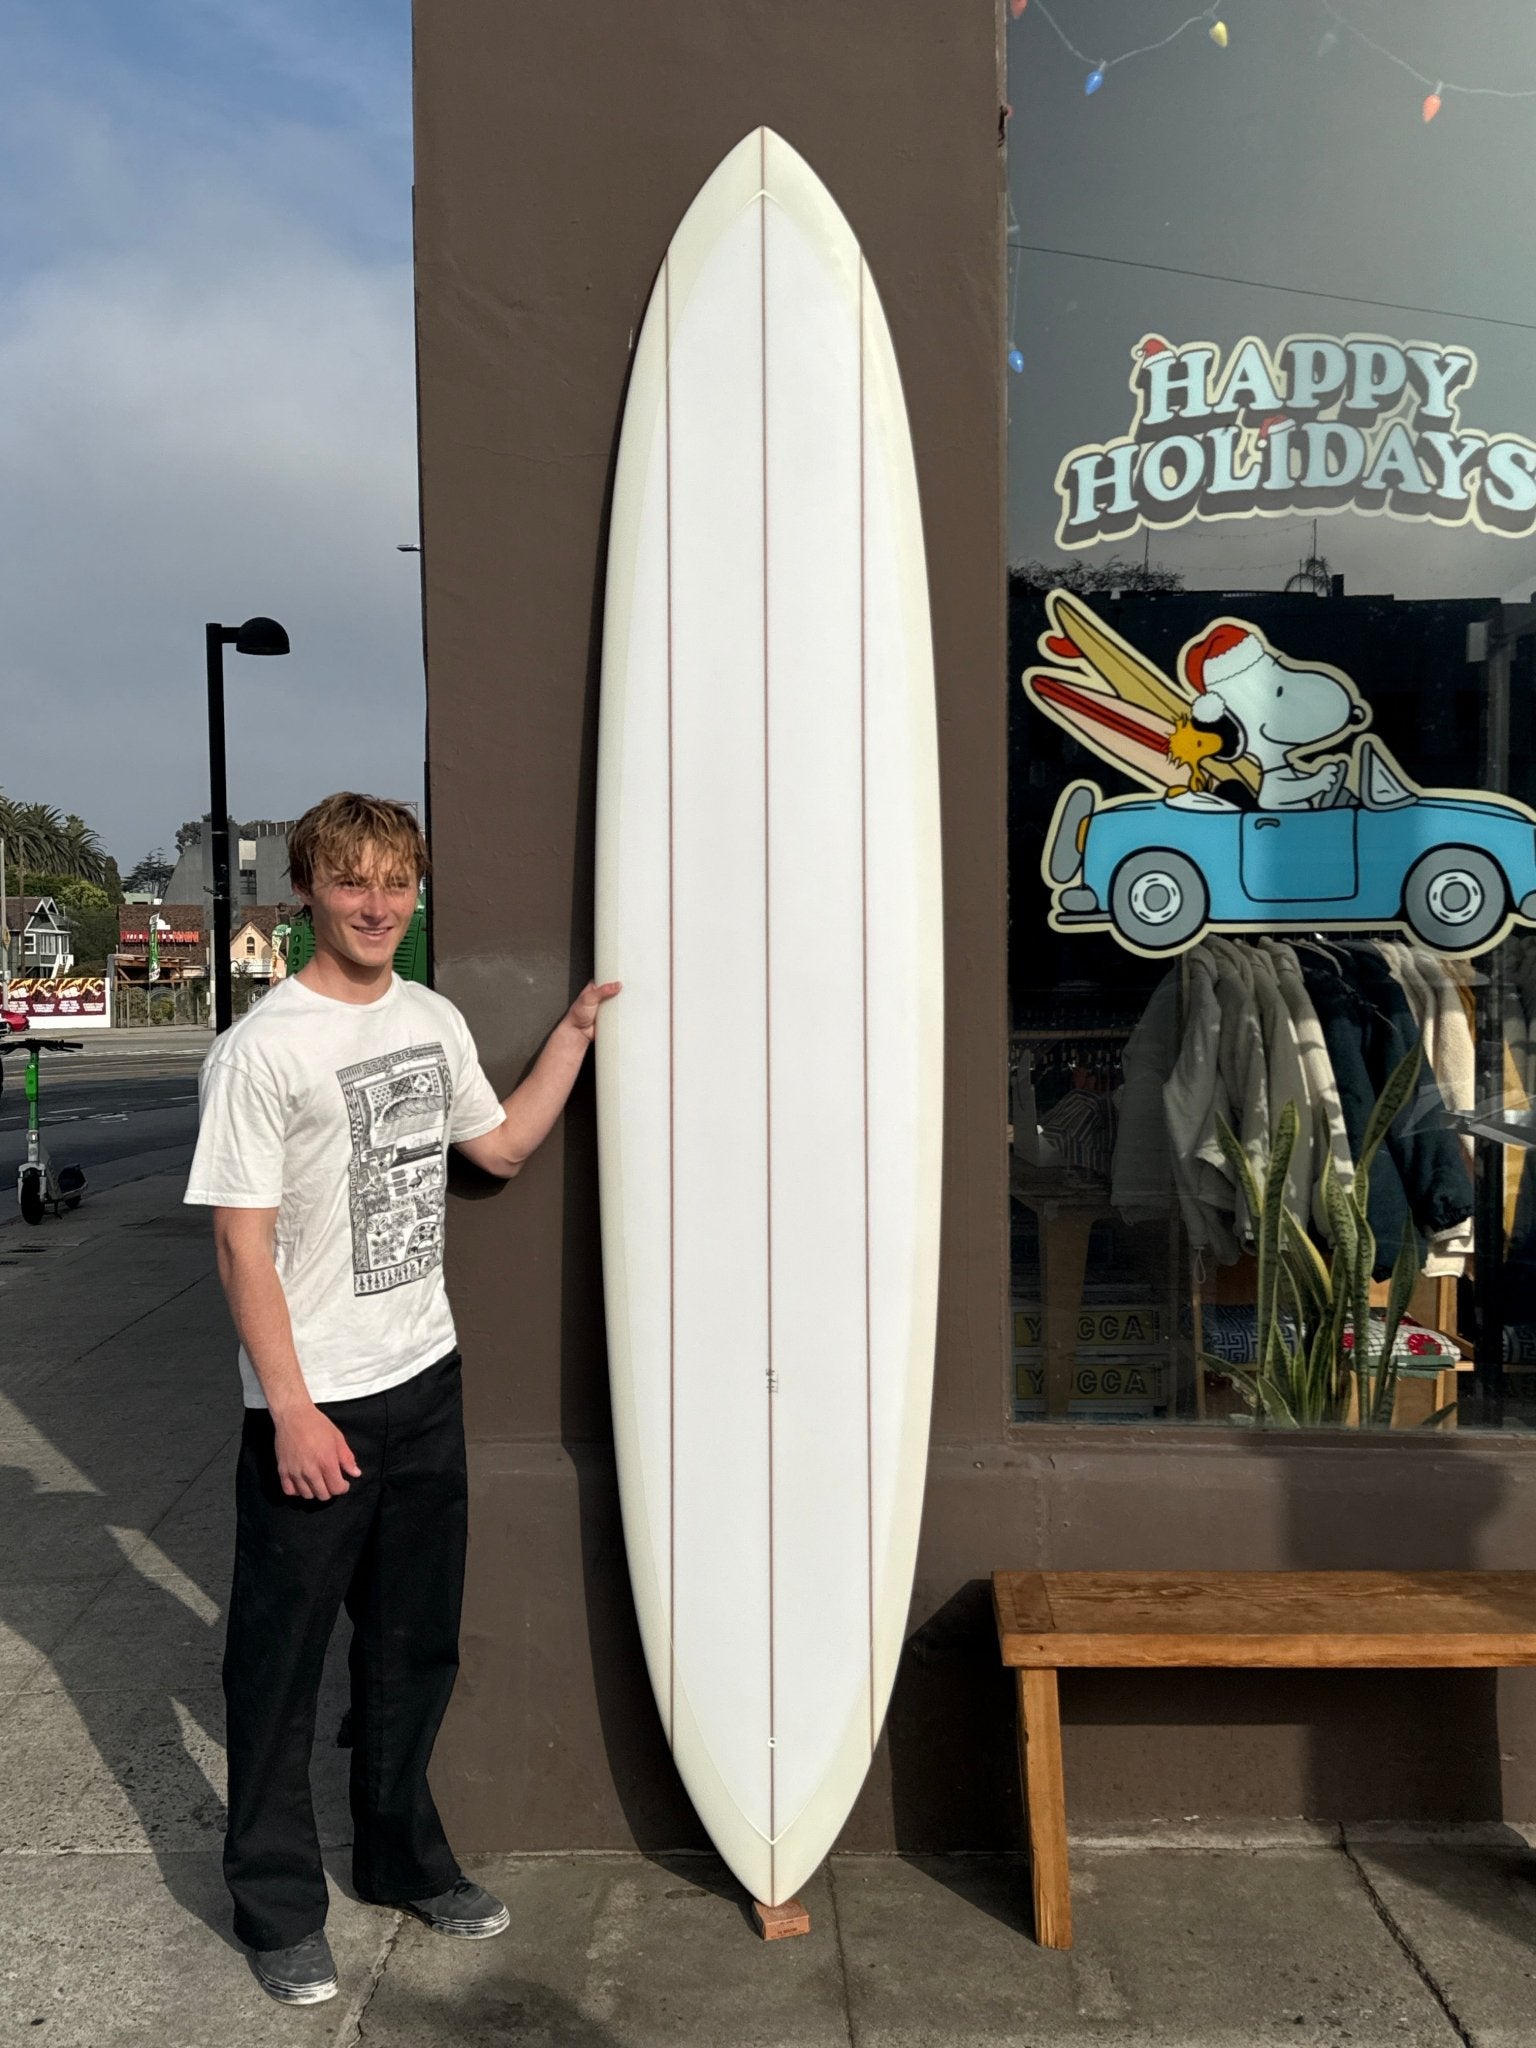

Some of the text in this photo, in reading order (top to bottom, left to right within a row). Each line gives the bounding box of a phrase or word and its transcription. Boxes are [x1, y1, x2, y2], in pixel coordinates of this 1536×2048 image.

[1140, 334, 1473, 428] HAPPY
[1064, 420, 1536, 530] HOLIDAYS
[1025, 1315, 1145, 1341] YCCA
[1026, 1369, 1146, 1394] YCCA
